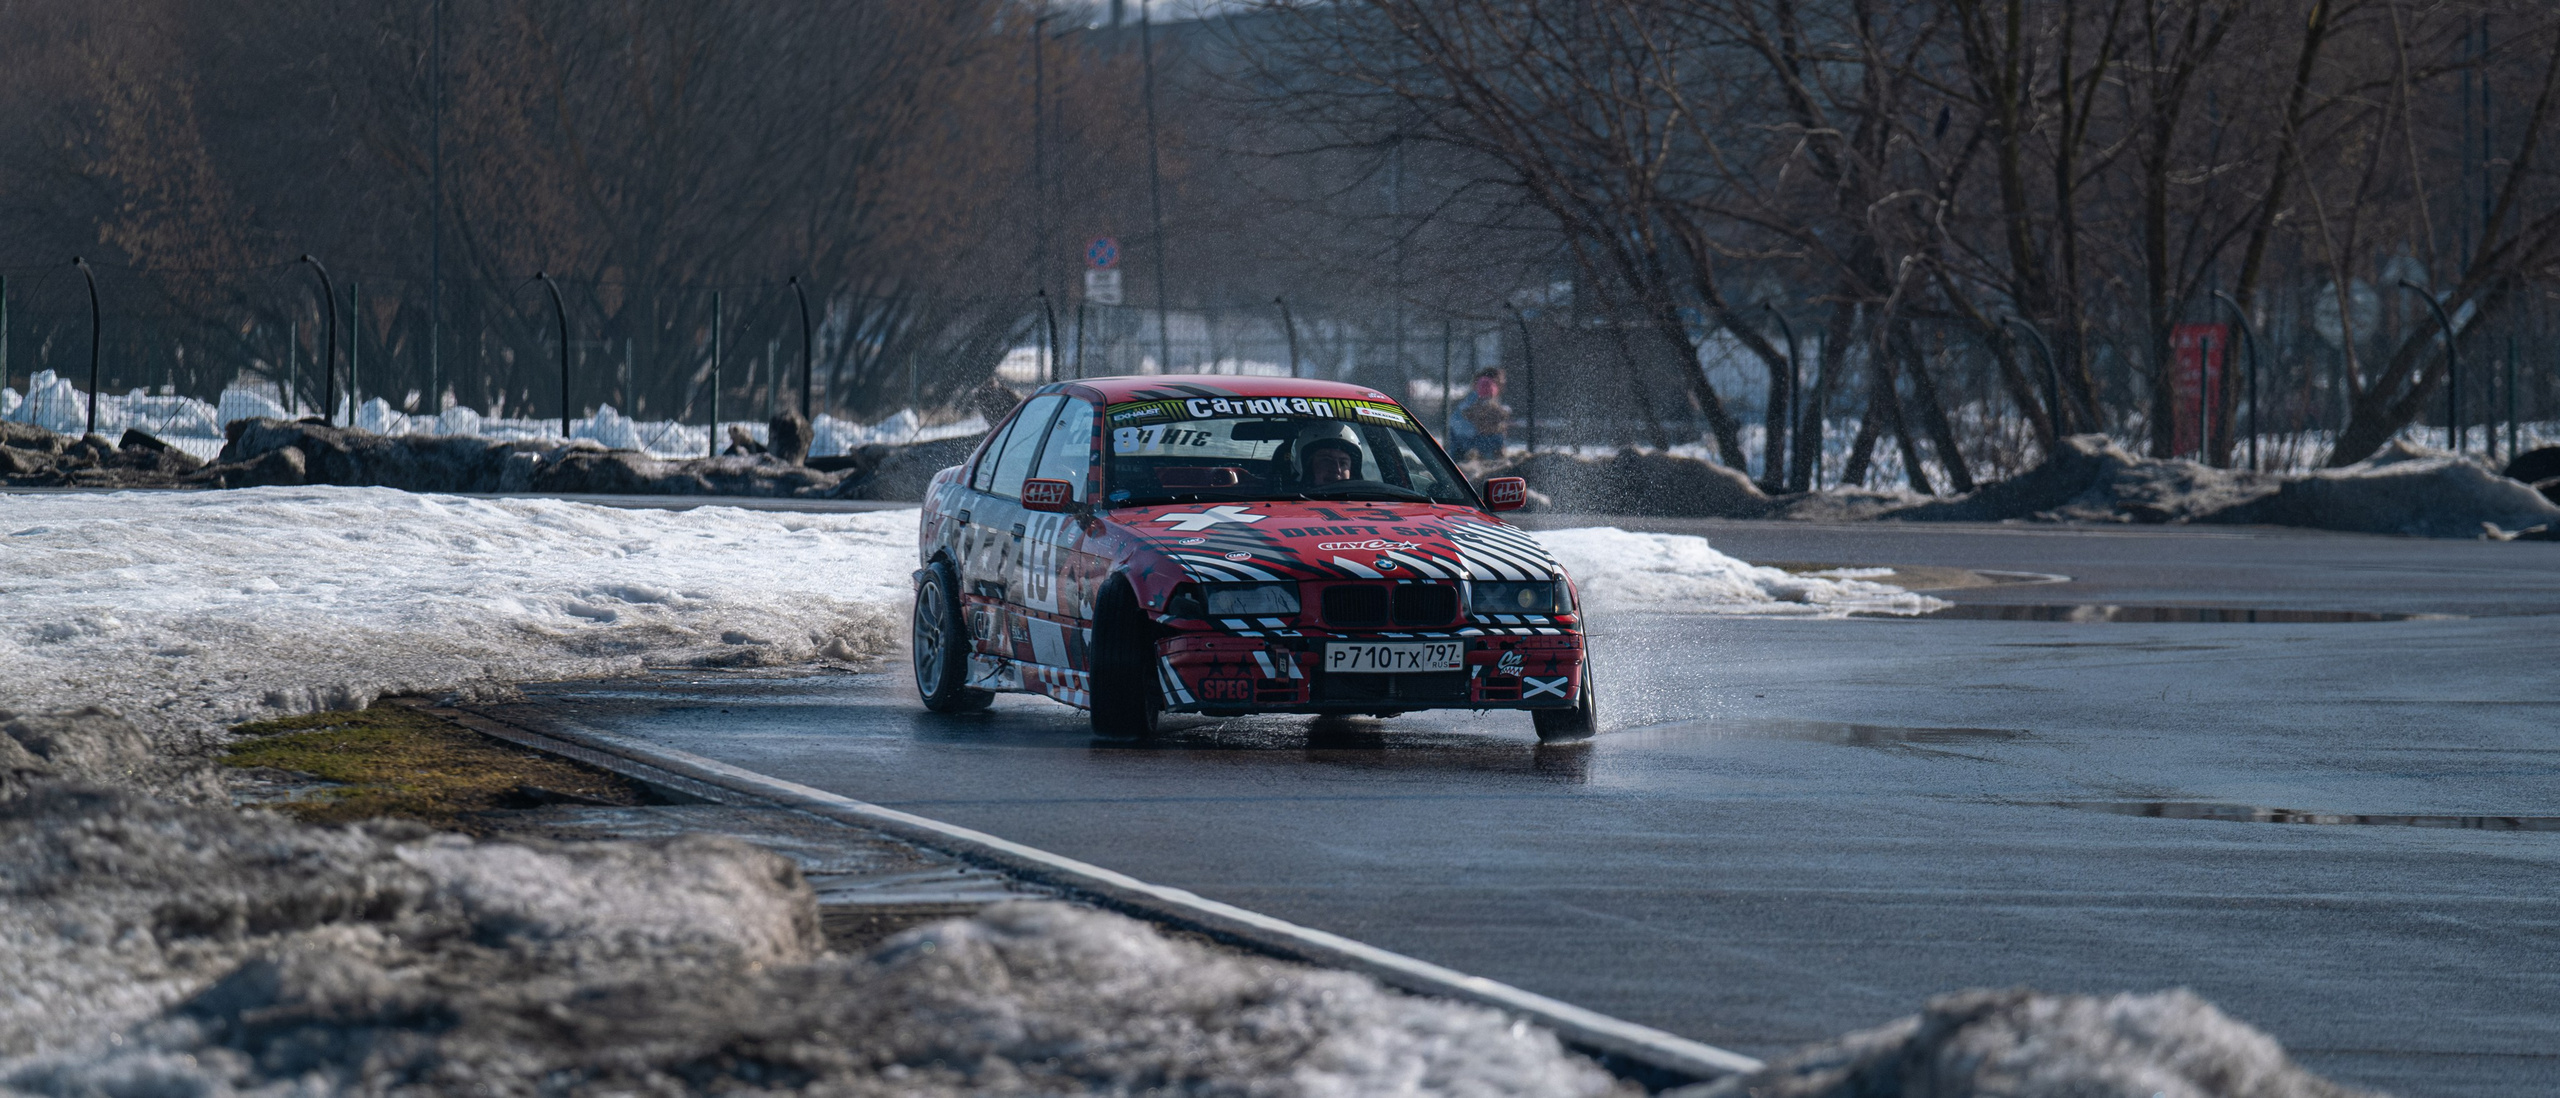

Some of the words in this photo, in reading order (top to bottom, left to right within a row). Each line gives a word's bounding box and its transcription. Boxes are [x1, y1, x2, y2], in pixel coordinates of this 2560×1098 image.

[1113, 424, 1165, 454] 87
[1304, 507, 1407, 522] 13
[1278, 525, 1380, 538] DRIFT
[1027, 513, 1058, 602] 13
[1425, 644, 1457, 662] 797
[1203, 680, 1248, 699] SPEC
